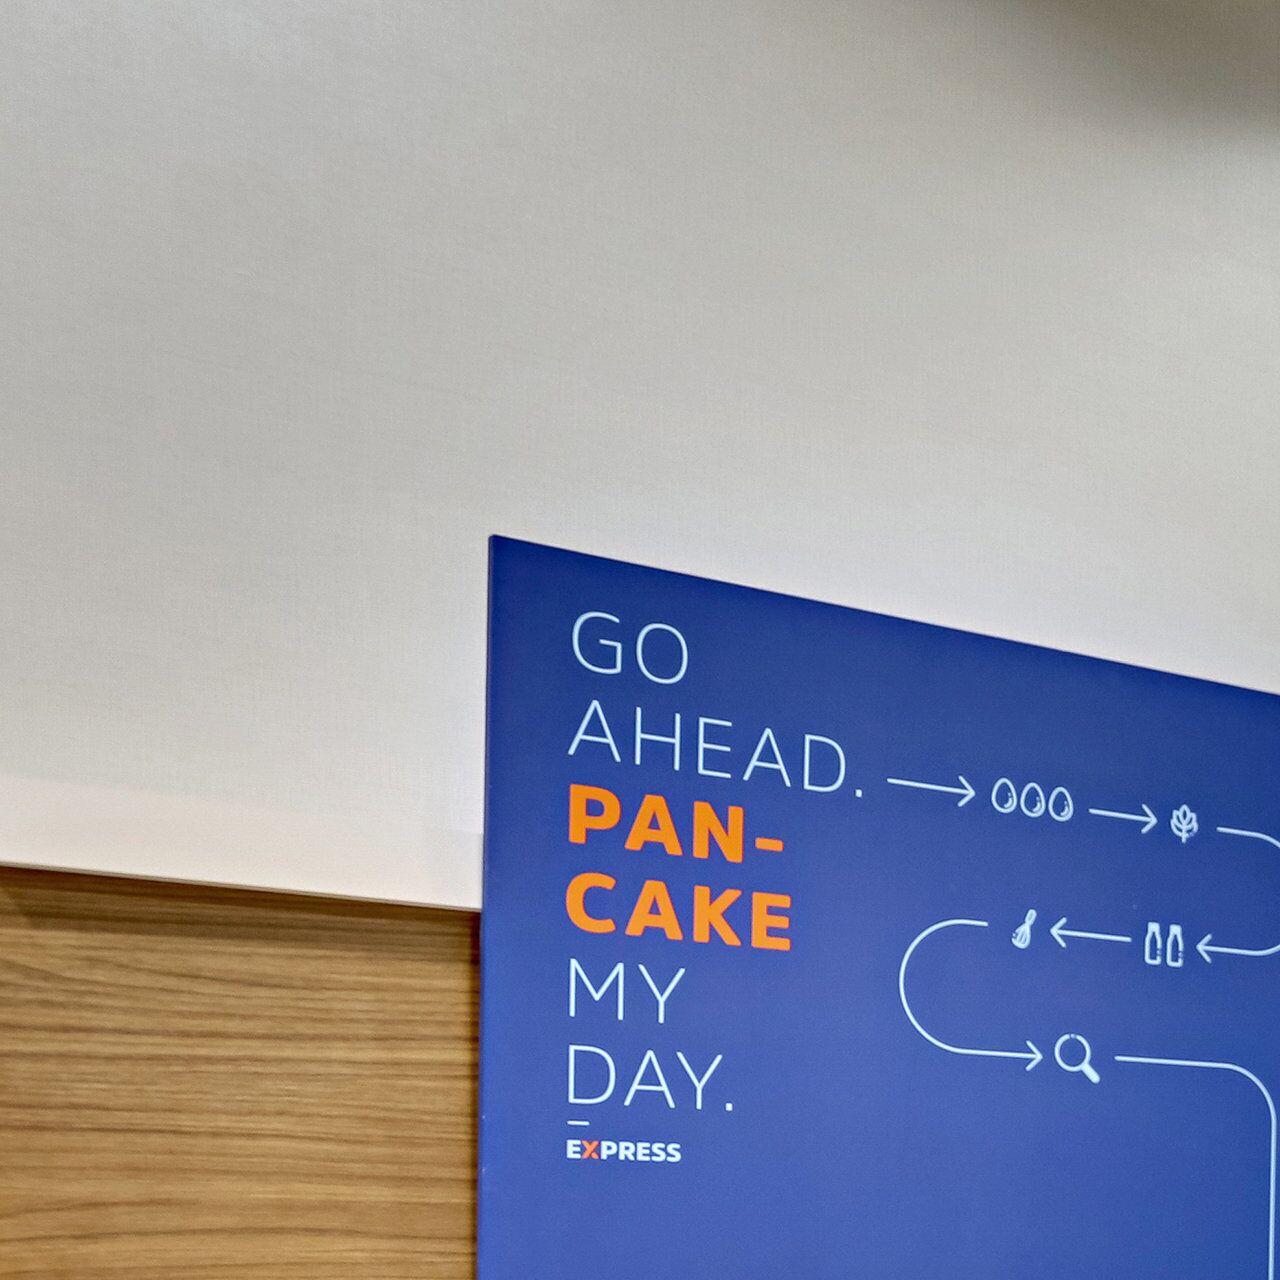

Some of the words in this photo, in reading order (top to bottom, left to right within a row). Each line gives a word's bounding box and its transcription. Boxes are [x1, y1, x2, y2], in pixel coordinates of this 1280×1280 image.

[572, 611, 688, 684] GO
[568, 699, 863, 798] AHEAD.
[568, 783, 785, 864] PAN-
[565, 872, 792, 952] CAKE
[568, 958, 686, 1024] MY
[567, 1044, 734, 1112] DAY.
[566, 1139, 682, 1163] EXPRESS
